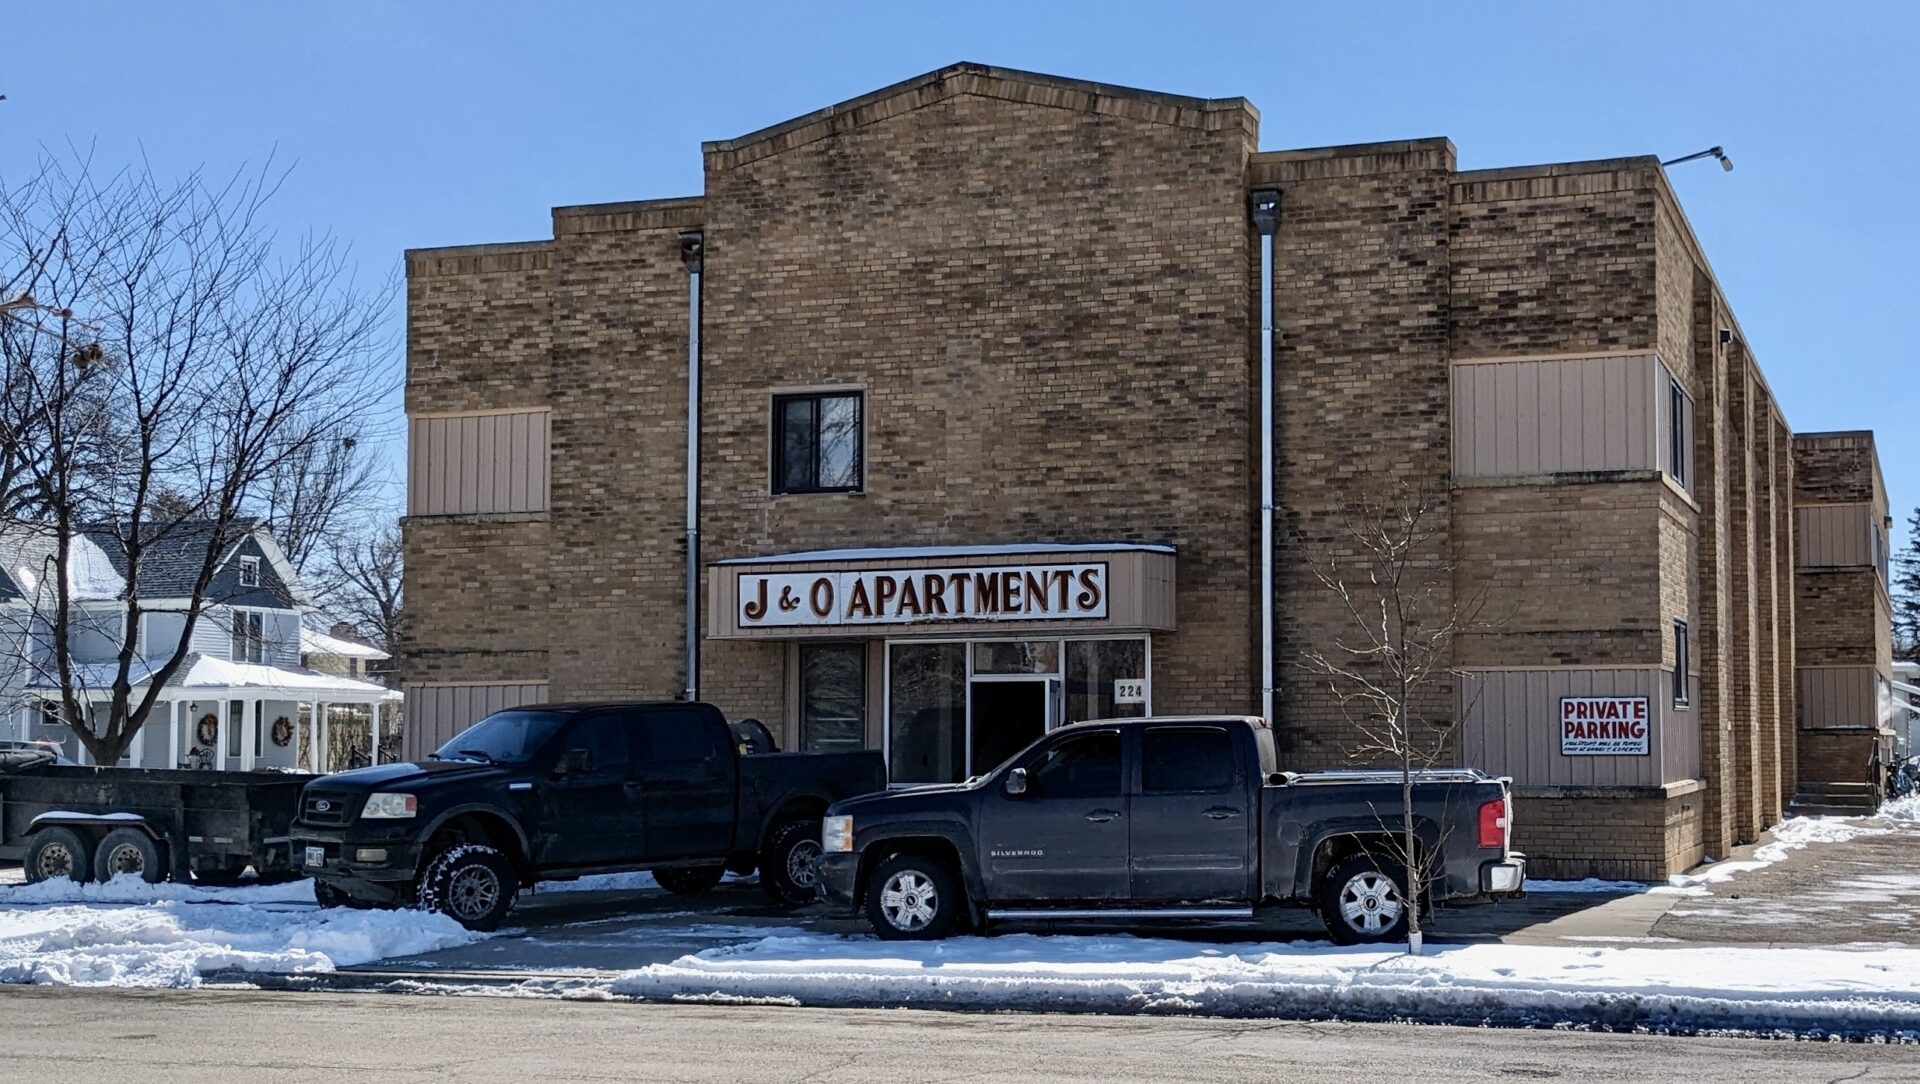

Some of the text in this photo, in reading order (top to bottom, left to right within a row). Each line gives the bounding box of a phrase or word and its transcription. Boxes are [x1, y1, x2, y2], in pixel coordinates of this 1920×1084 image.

[744, 568, 1101, 621] J & O APARTMENTS
[1120, 685, 1142, 697] 224
[1563, 701, 1645, 719] PRIVATE
[1564, 721, 1645, 739] PARKING
